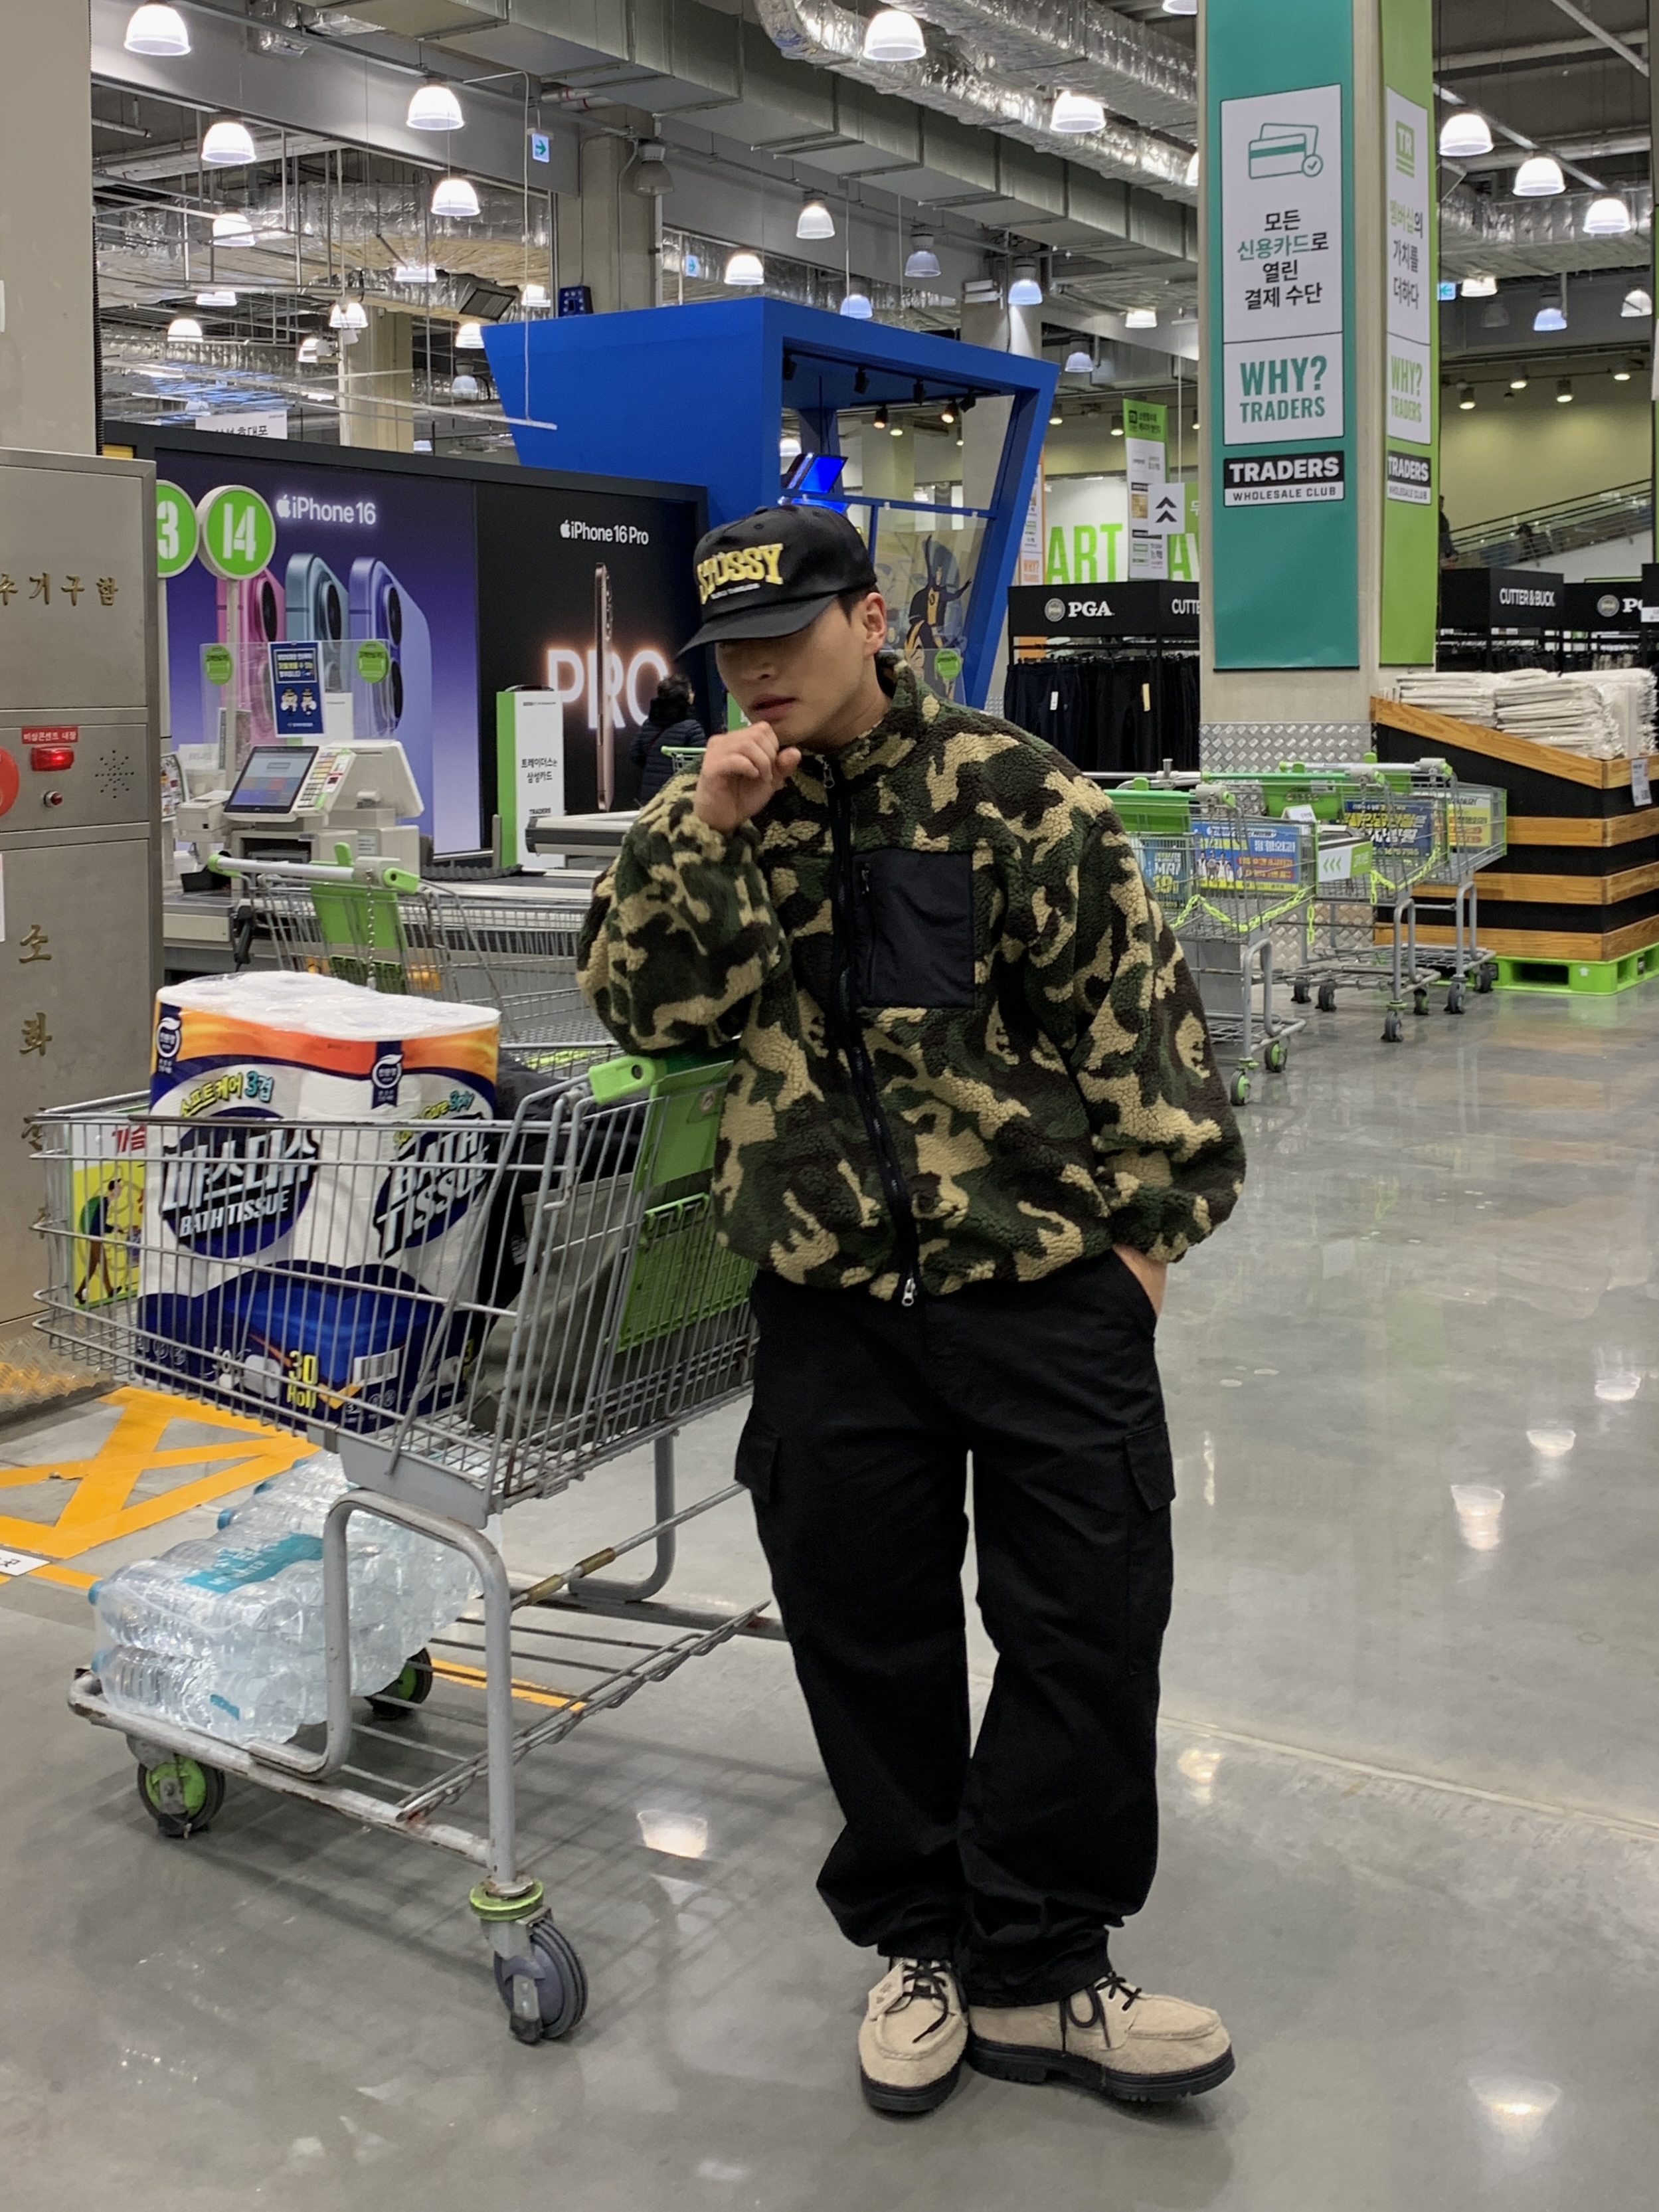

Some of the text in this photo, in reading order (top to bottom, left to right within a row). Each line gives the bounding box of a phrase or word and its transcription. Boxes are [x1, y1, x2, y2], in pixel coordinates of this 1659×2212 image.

[1264, 209, 1301, 232] 모든
[1237, 232, 1329, 261] 신용카드로
[1393, 239, 1419, 274] 가치를
[1263, 260, 1298, 283] 열린
[1245, 282, 1323, 310] 결제 수단
[1393, 276, 1419, 310] 더하다
[1240, 355, 1328, 397] WHY?
[1391, 355, 1423, 397] WHY?
[1240, 396, 1326, 423] TRADERS
[1391, 396, 1422, 423] TRADERS
[1229, 456, 1340, 484] TRADERS
[1389, 456, 1429, 482] TRADERS
[1233, 486, 1336, 502] WHOLESALE CLUB
[293, 496, 377, 525] iPhone 16
[222, 502, 256, 561] 14
[570, 521, 649, 545] iPhone 16 Pro
[1068, 601, 1113, 618] PGA
[548, 649, 670, 729] PRO
[24, 731, 76, 742] 비상콘센트 내장
[527, 771, 553, 784] 삼성카드
[244, 1071, 274, 1103] 3겹
[179, 1190, 290, 1238] BATH TISSUE
[289, 1350, 317, 1385] 30
